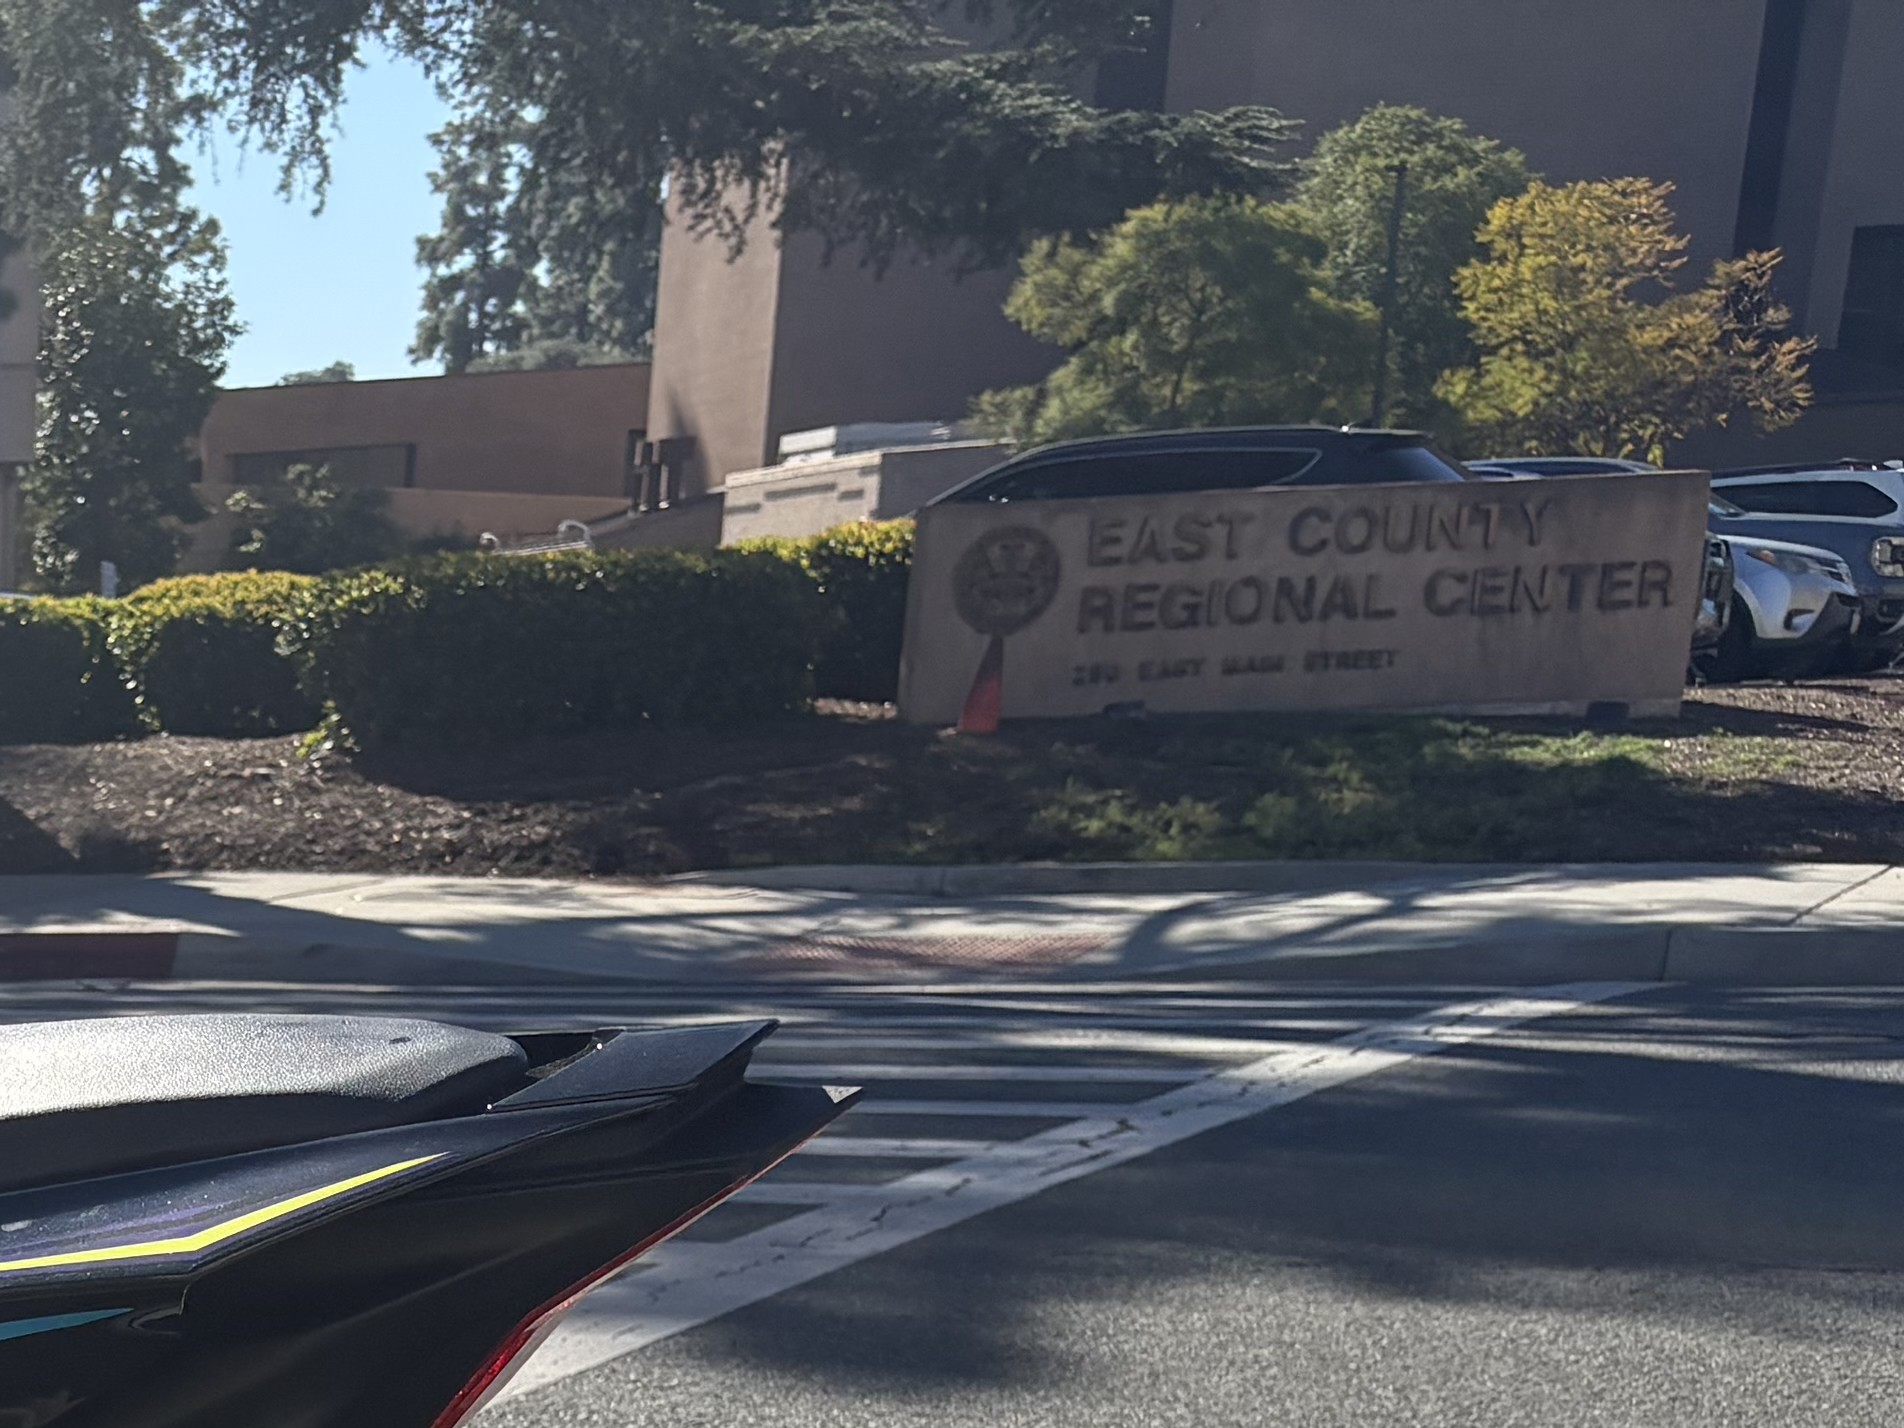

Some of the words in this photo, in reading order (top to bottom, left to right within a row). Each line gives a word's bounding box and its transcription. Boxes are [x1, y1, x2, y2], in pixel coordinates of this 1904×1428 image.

[1086, 510, 1255, 569] EAST
[1288, 499, 1552, 558] COUNTY
[1075, 571, 1398, 634] REGIONAL
[1423, 557, 1677, 616] CENTER
